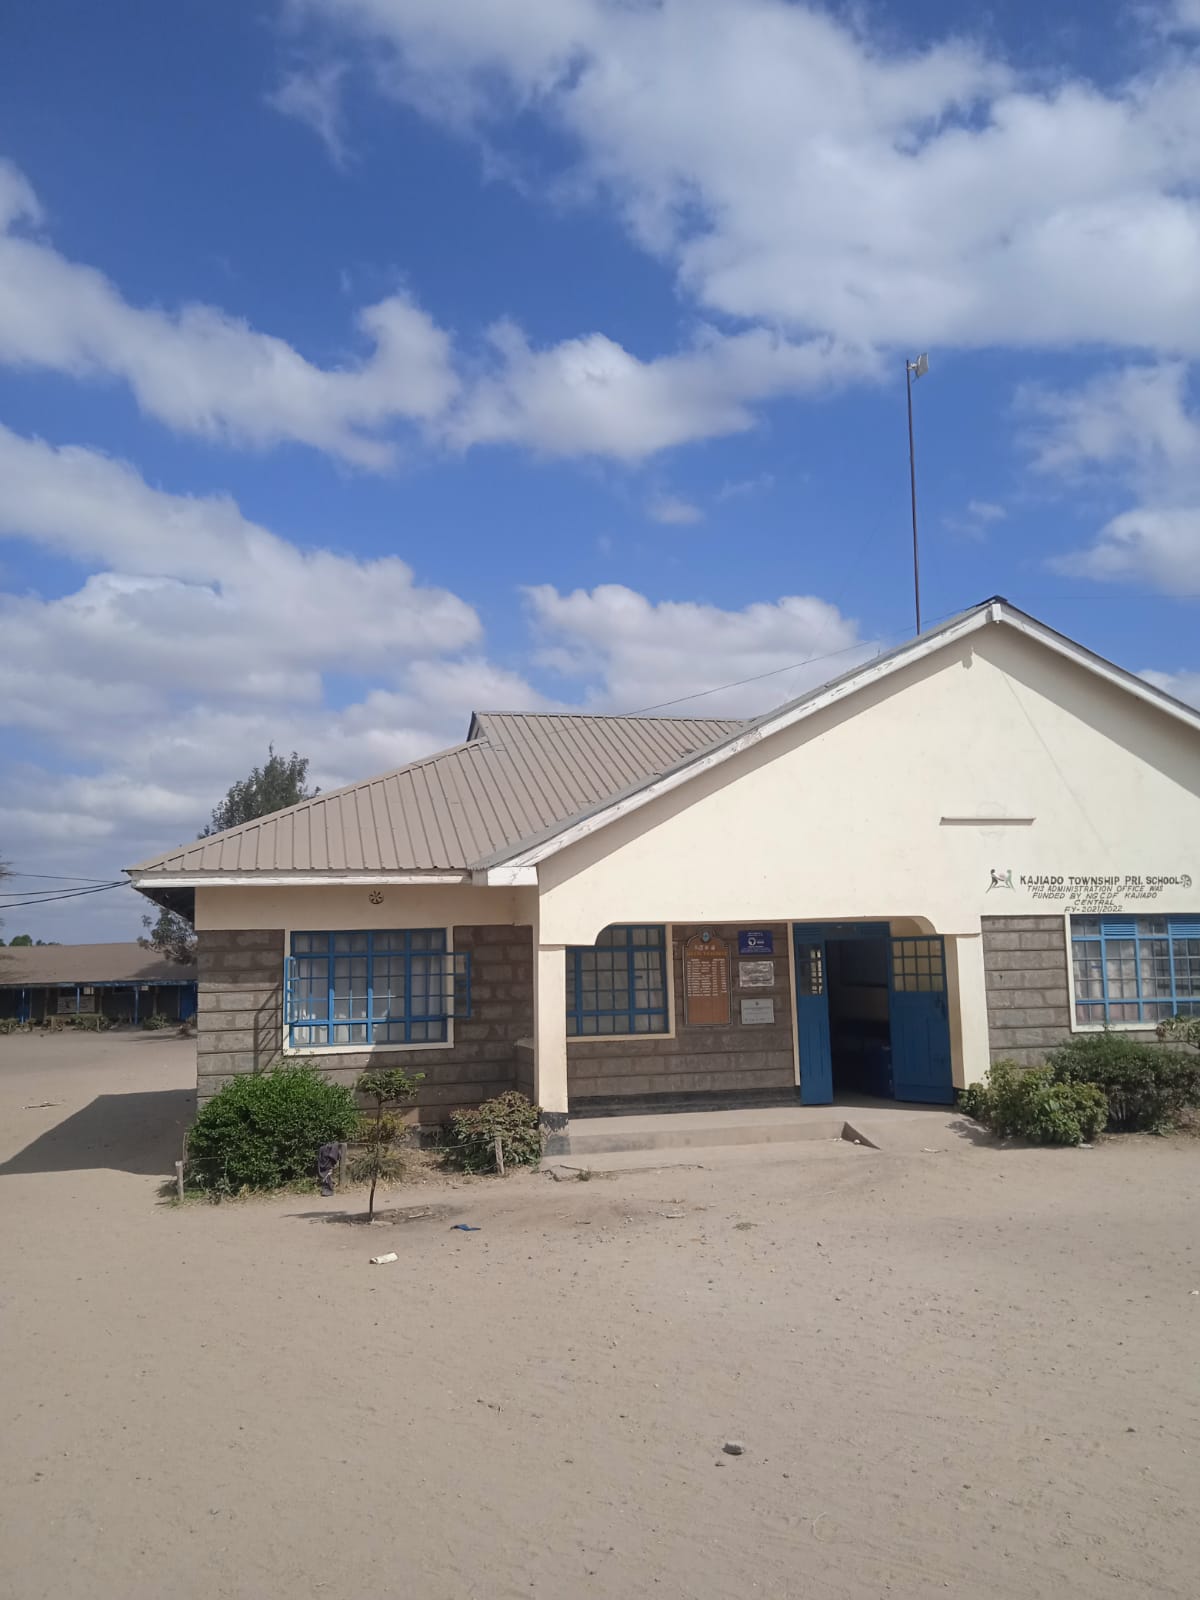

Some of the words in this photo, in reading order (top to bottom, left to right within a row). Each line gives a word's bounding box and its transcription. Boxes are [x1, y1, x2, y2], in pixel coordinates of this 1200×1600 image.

[1020, 875, 1064, 885] KAJIADO
[1068, 876, 1120, 886] TOWNSHIP
[1047, 885, 1112, 893] ADMINISTRATION
